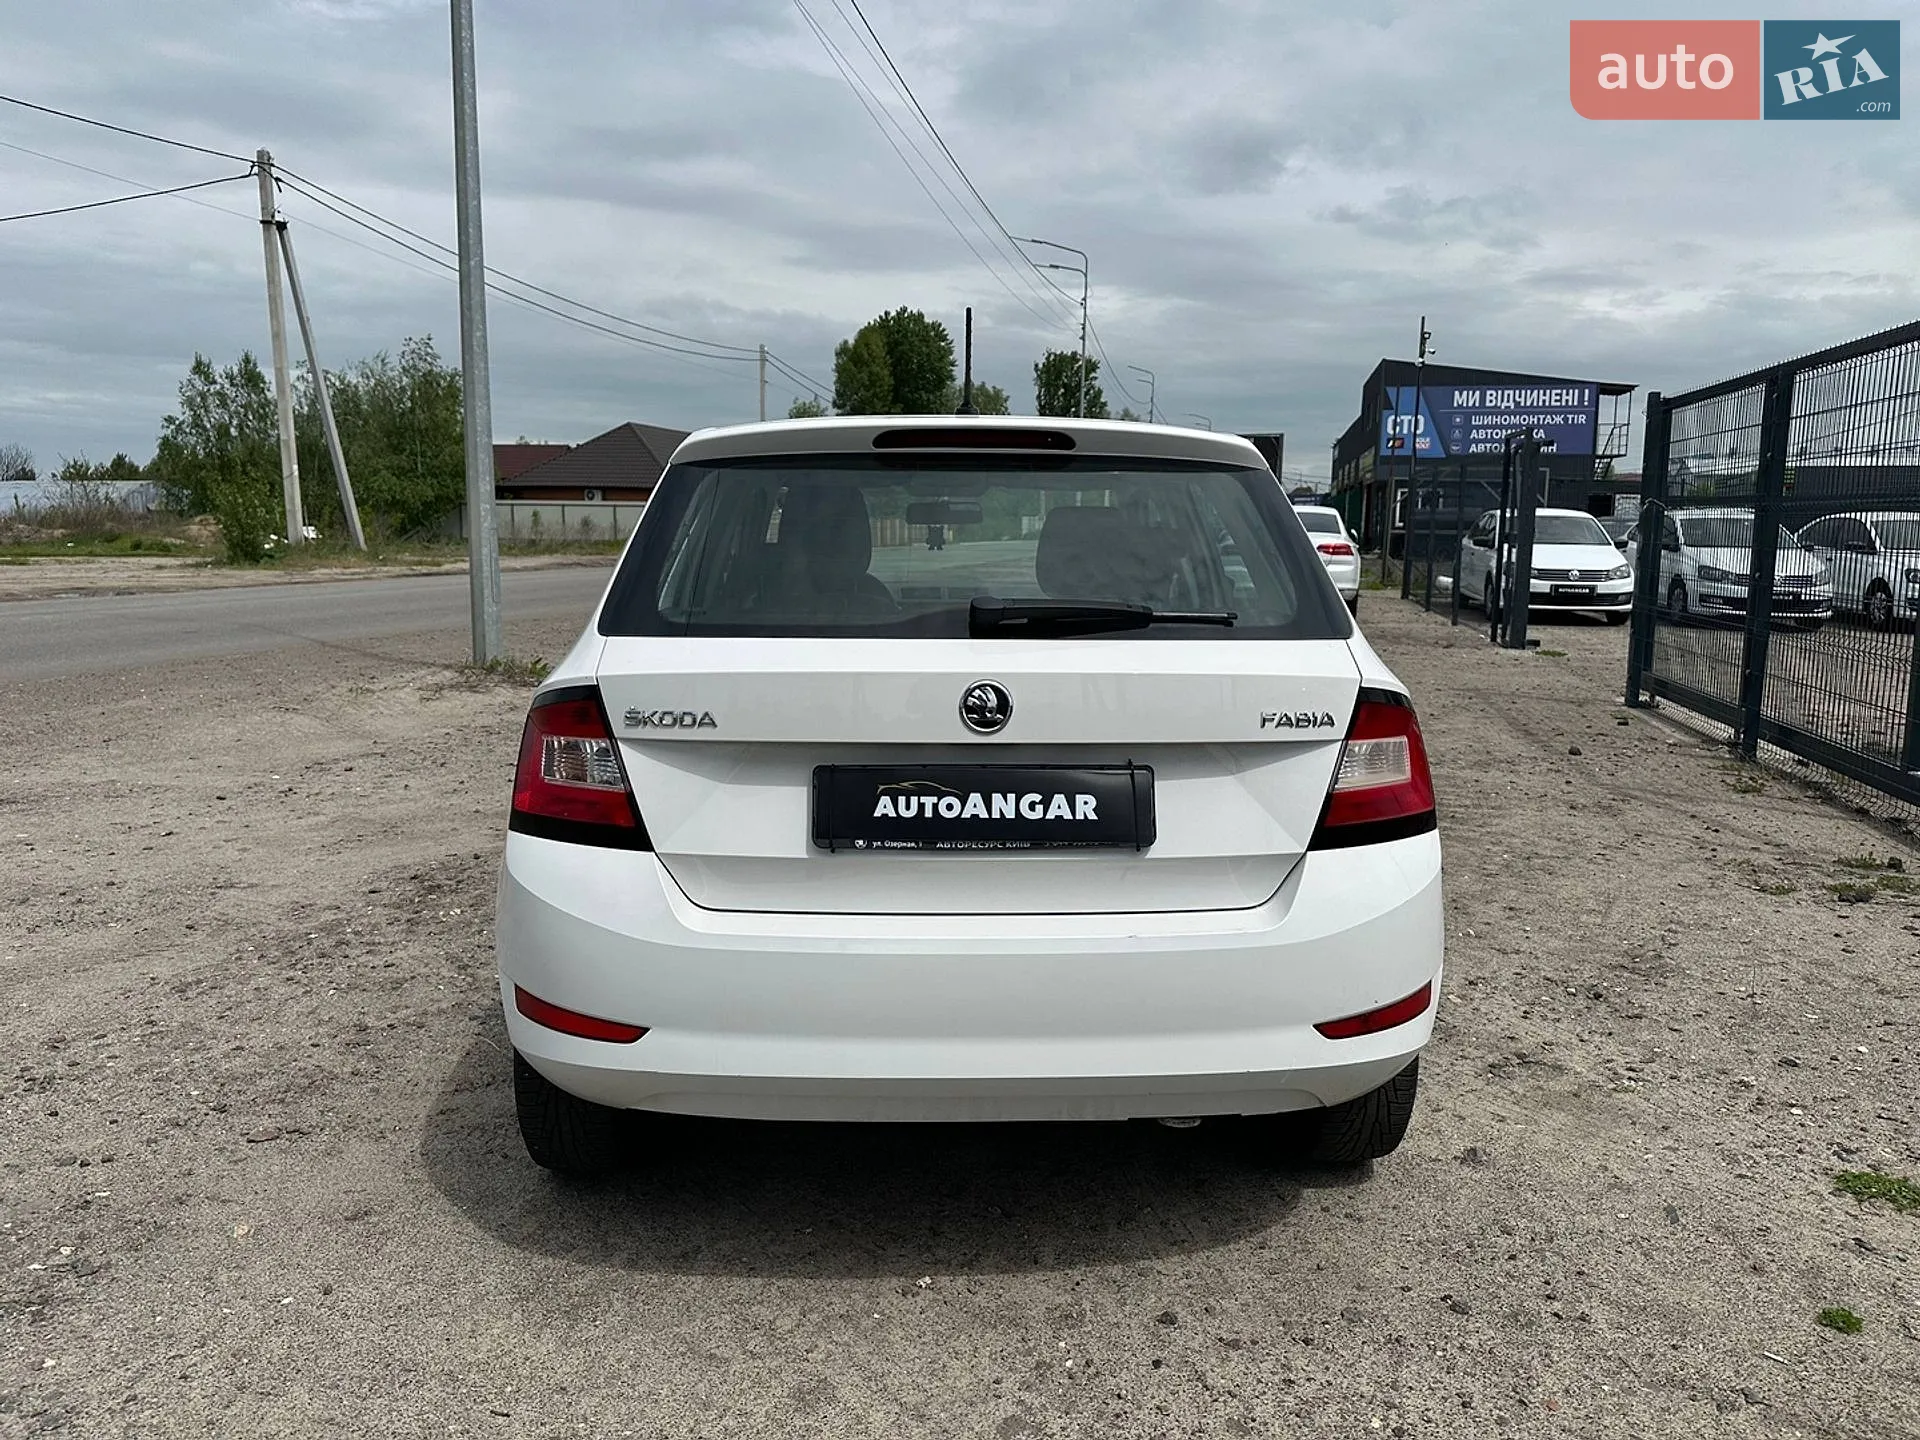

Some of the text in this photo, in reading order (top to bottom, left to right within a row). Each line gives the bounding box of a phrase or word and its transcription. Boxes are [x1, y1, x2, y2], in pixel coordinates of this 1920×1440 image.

[1453, 391, 1480, 408] МИ
[1485, 389, 1579, 410] ВІДЧИНЕНІ
[1386, 414, 1425, 435] СТО
[1471, 414, 1587, 426] ШИНОМОНТАЖ TIR
[623, 705, 718, 729] ŠKODA
[1260, 711, 1336, 729] FABIA
[873, 791, 1099, 820] AUTOANGAR
